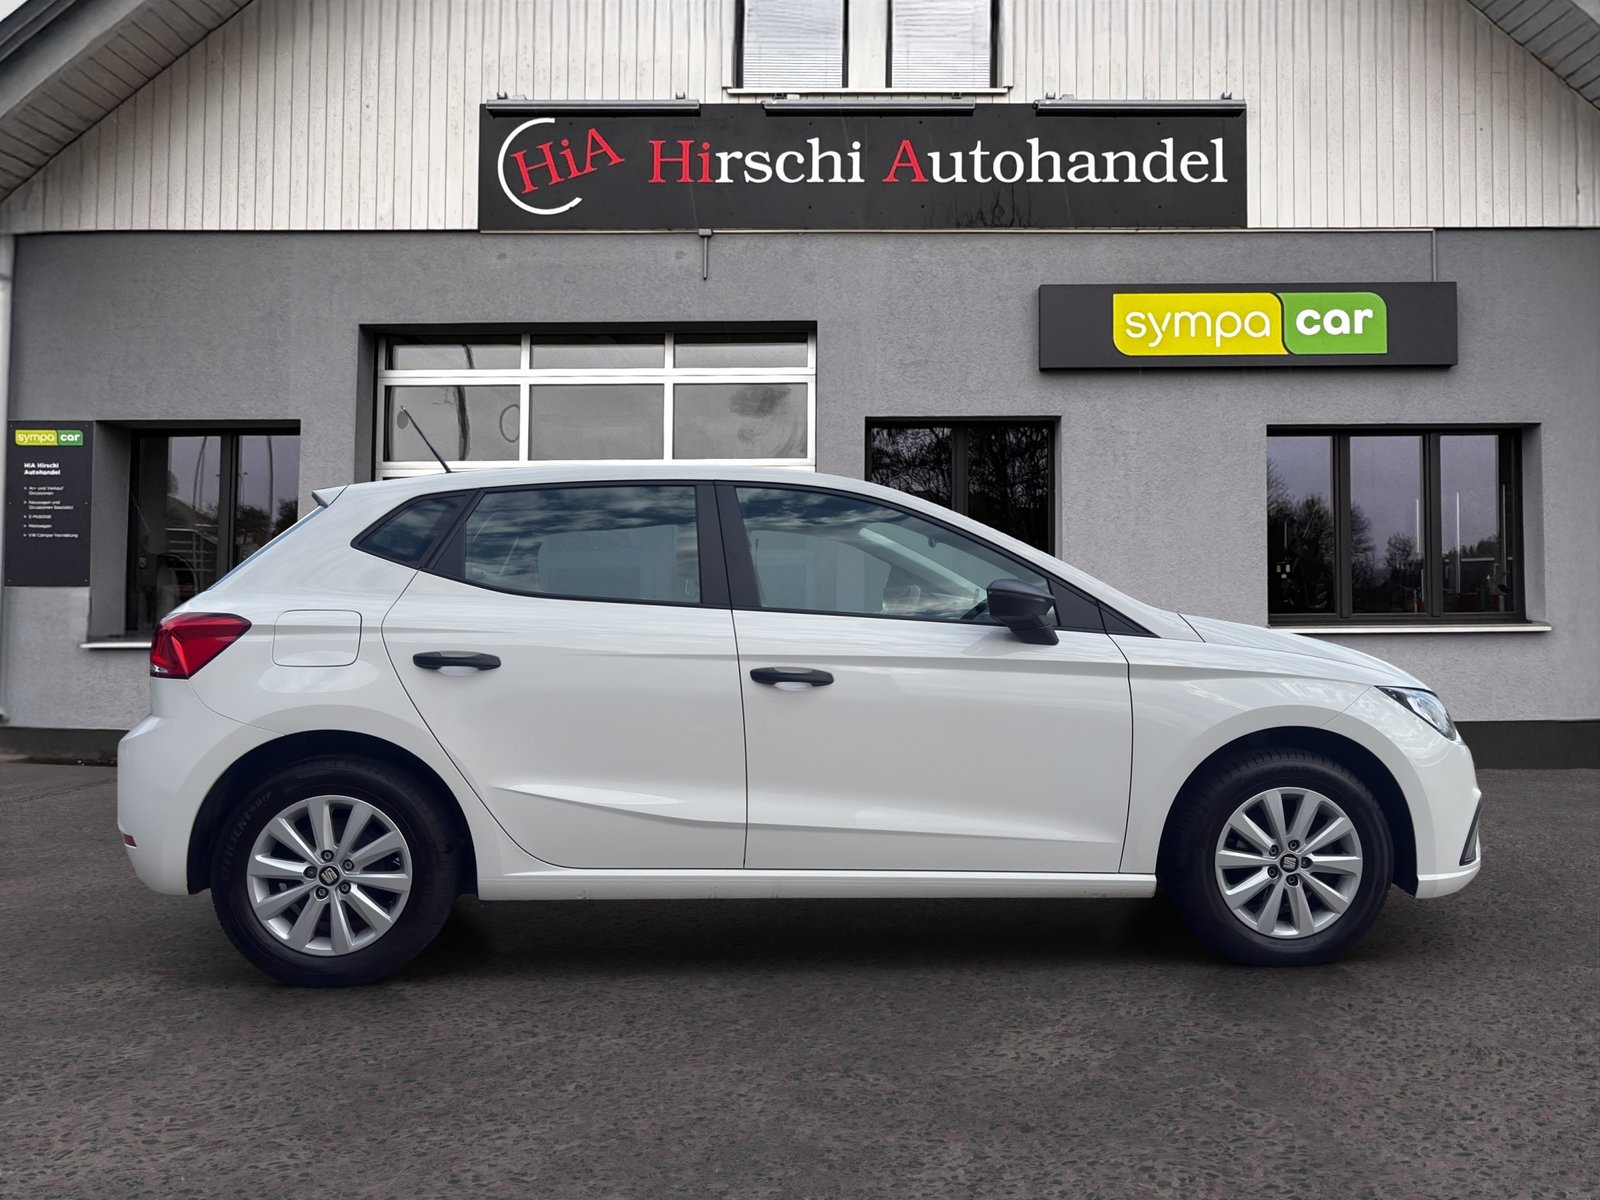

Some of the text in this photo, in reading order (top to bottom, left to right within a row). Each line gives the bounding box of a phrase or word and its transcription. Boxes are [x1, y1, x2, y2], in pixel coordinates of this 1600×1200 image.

[509, 128, 625, 194] HiA
[649, 137, 1228, 183] Hirschi Autohandel
[1124, 308, 1375, 348] sympa car
[18, 433, 81, 444] sympa car
